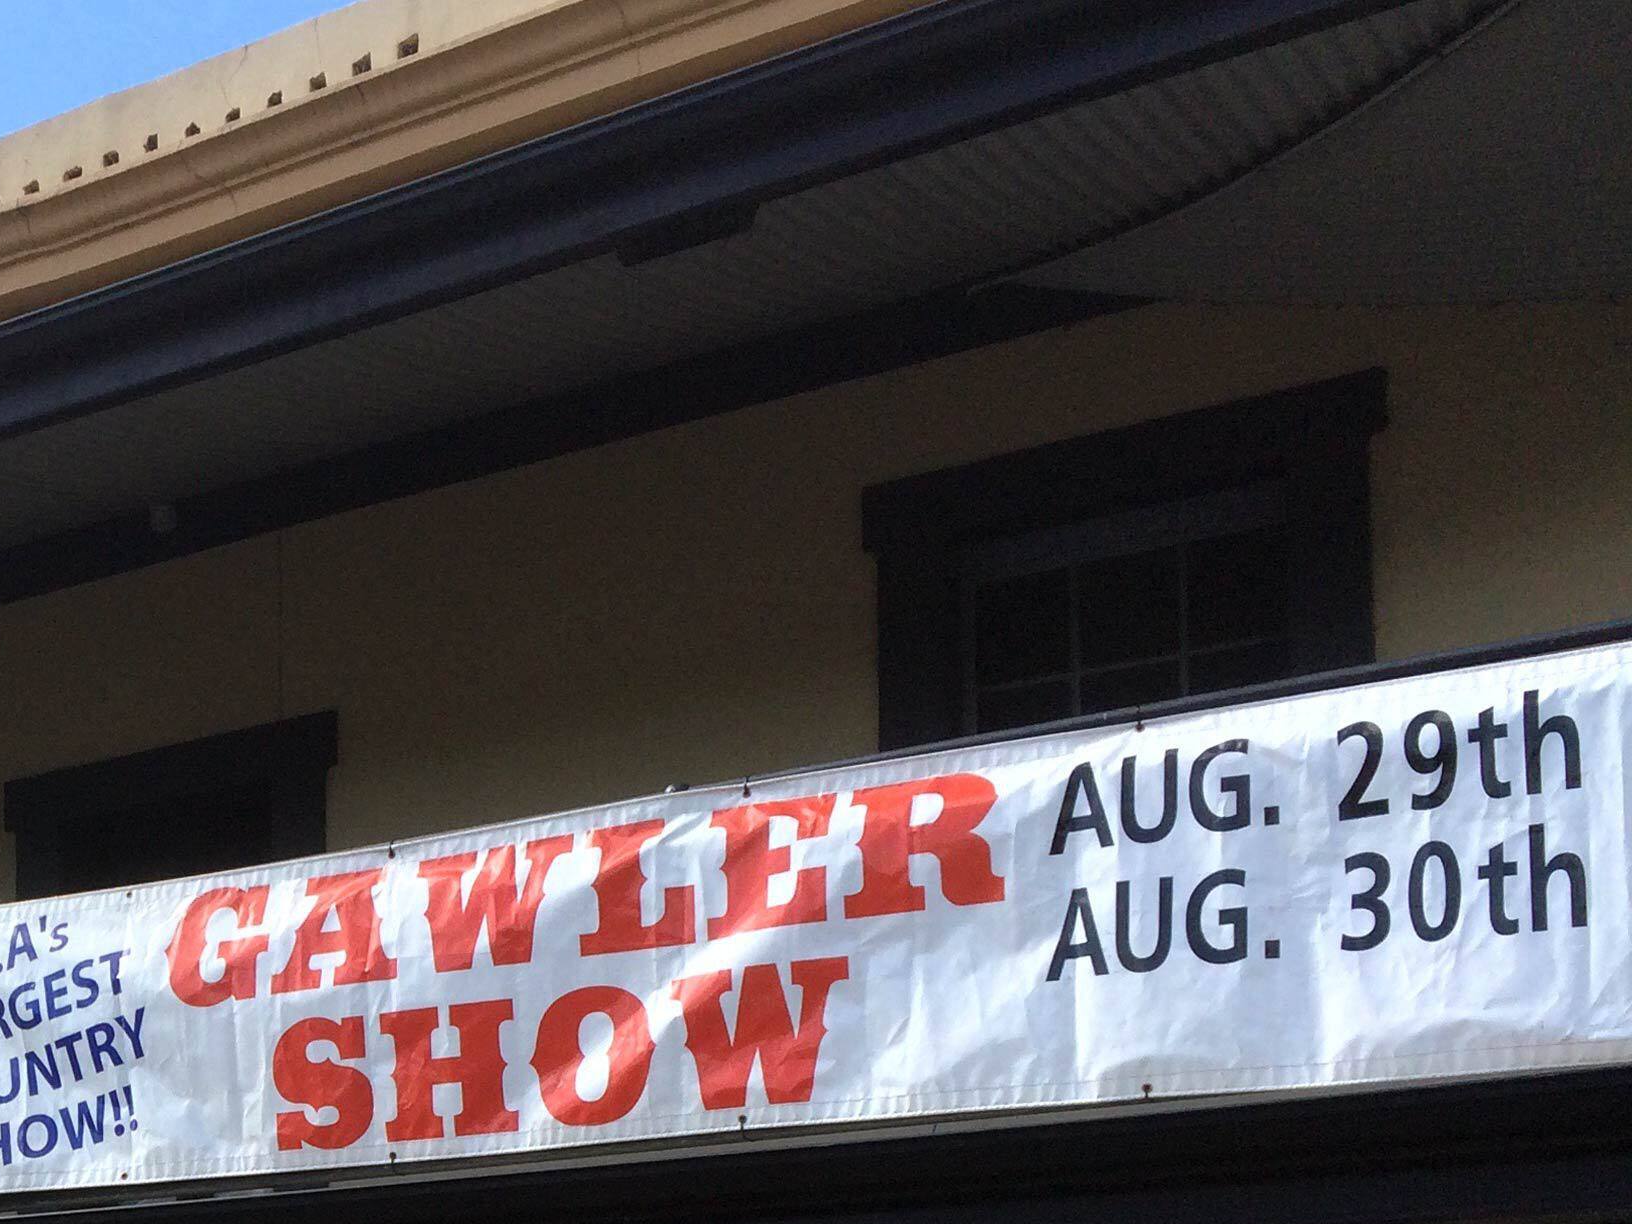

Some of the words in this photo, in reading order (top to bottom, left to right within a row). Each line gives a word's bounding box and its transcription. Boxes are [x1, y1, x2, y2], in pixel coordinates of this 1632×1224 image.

[1048, 737, 1281, 856] AUG.
[1336, 689, 1582, 821] 29th
[164, 771, 1006, 1008] GAWLER
[1044, 868, 1281, 983] AUG.
[1339, 824, 1589, 953] 30th
[271, 956, 851, 1151] SHOW
